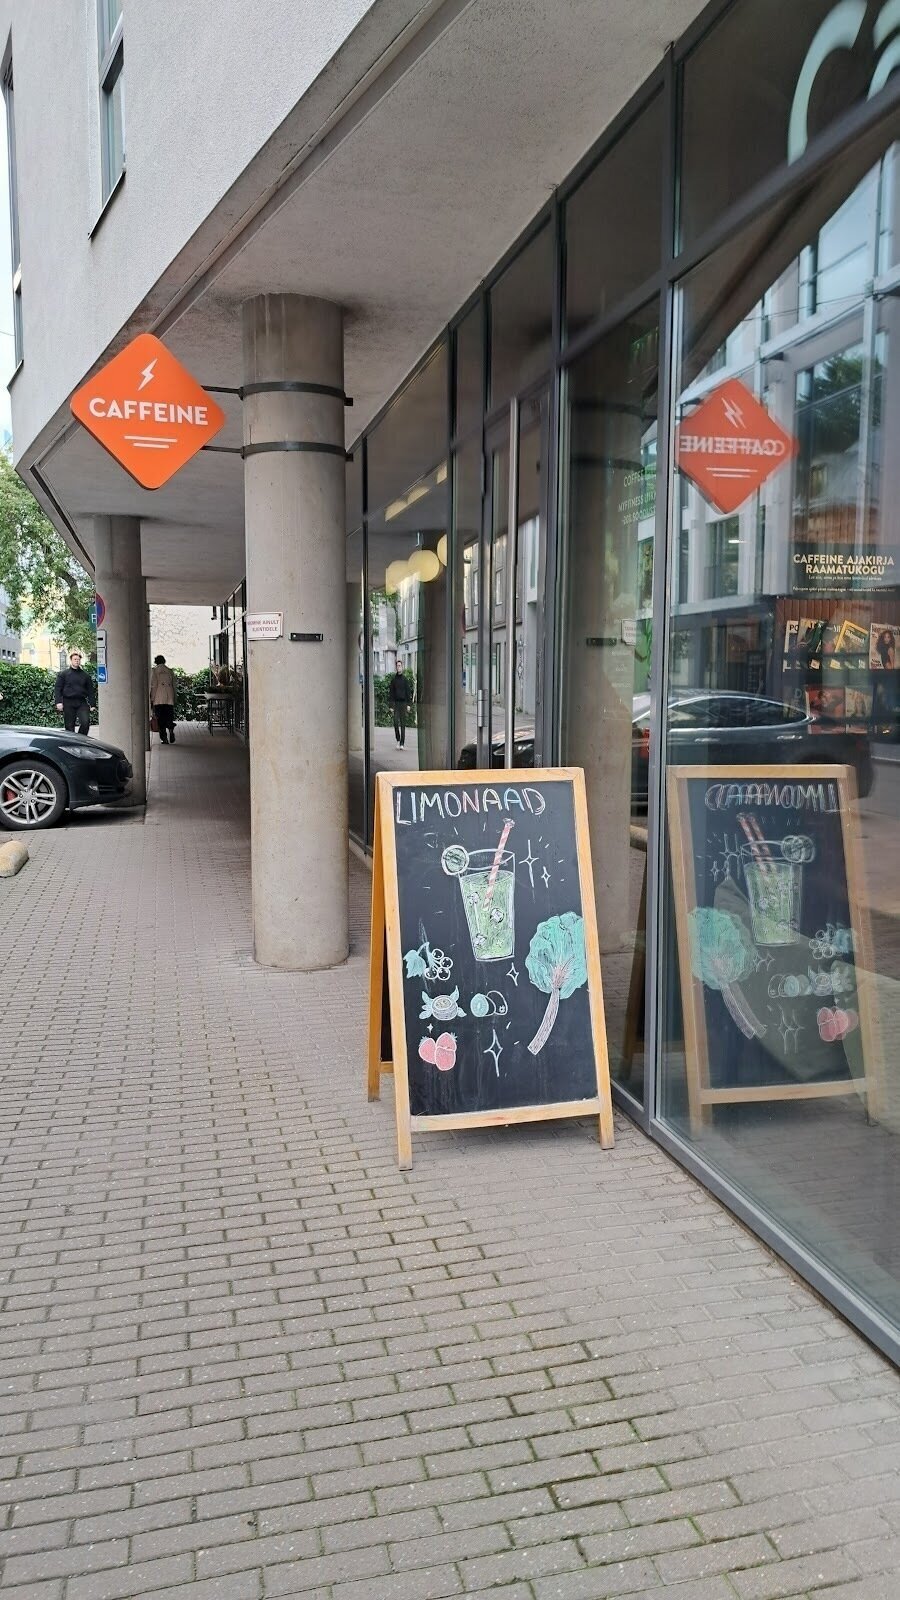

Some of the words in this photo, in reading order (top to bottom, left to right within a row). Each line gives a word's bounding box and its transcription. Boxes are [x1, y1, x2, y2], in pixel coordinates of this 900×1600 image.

[89, 397, 209, 426] CAFFEINE
[793, 554, 844, 564] CAFFEINE
[846, 555, 895, 566] AJAKIRJA
[805, 564, 885, 575] RAAMATUKOGU
[395, 787, 547, 826] LIMONAAD
